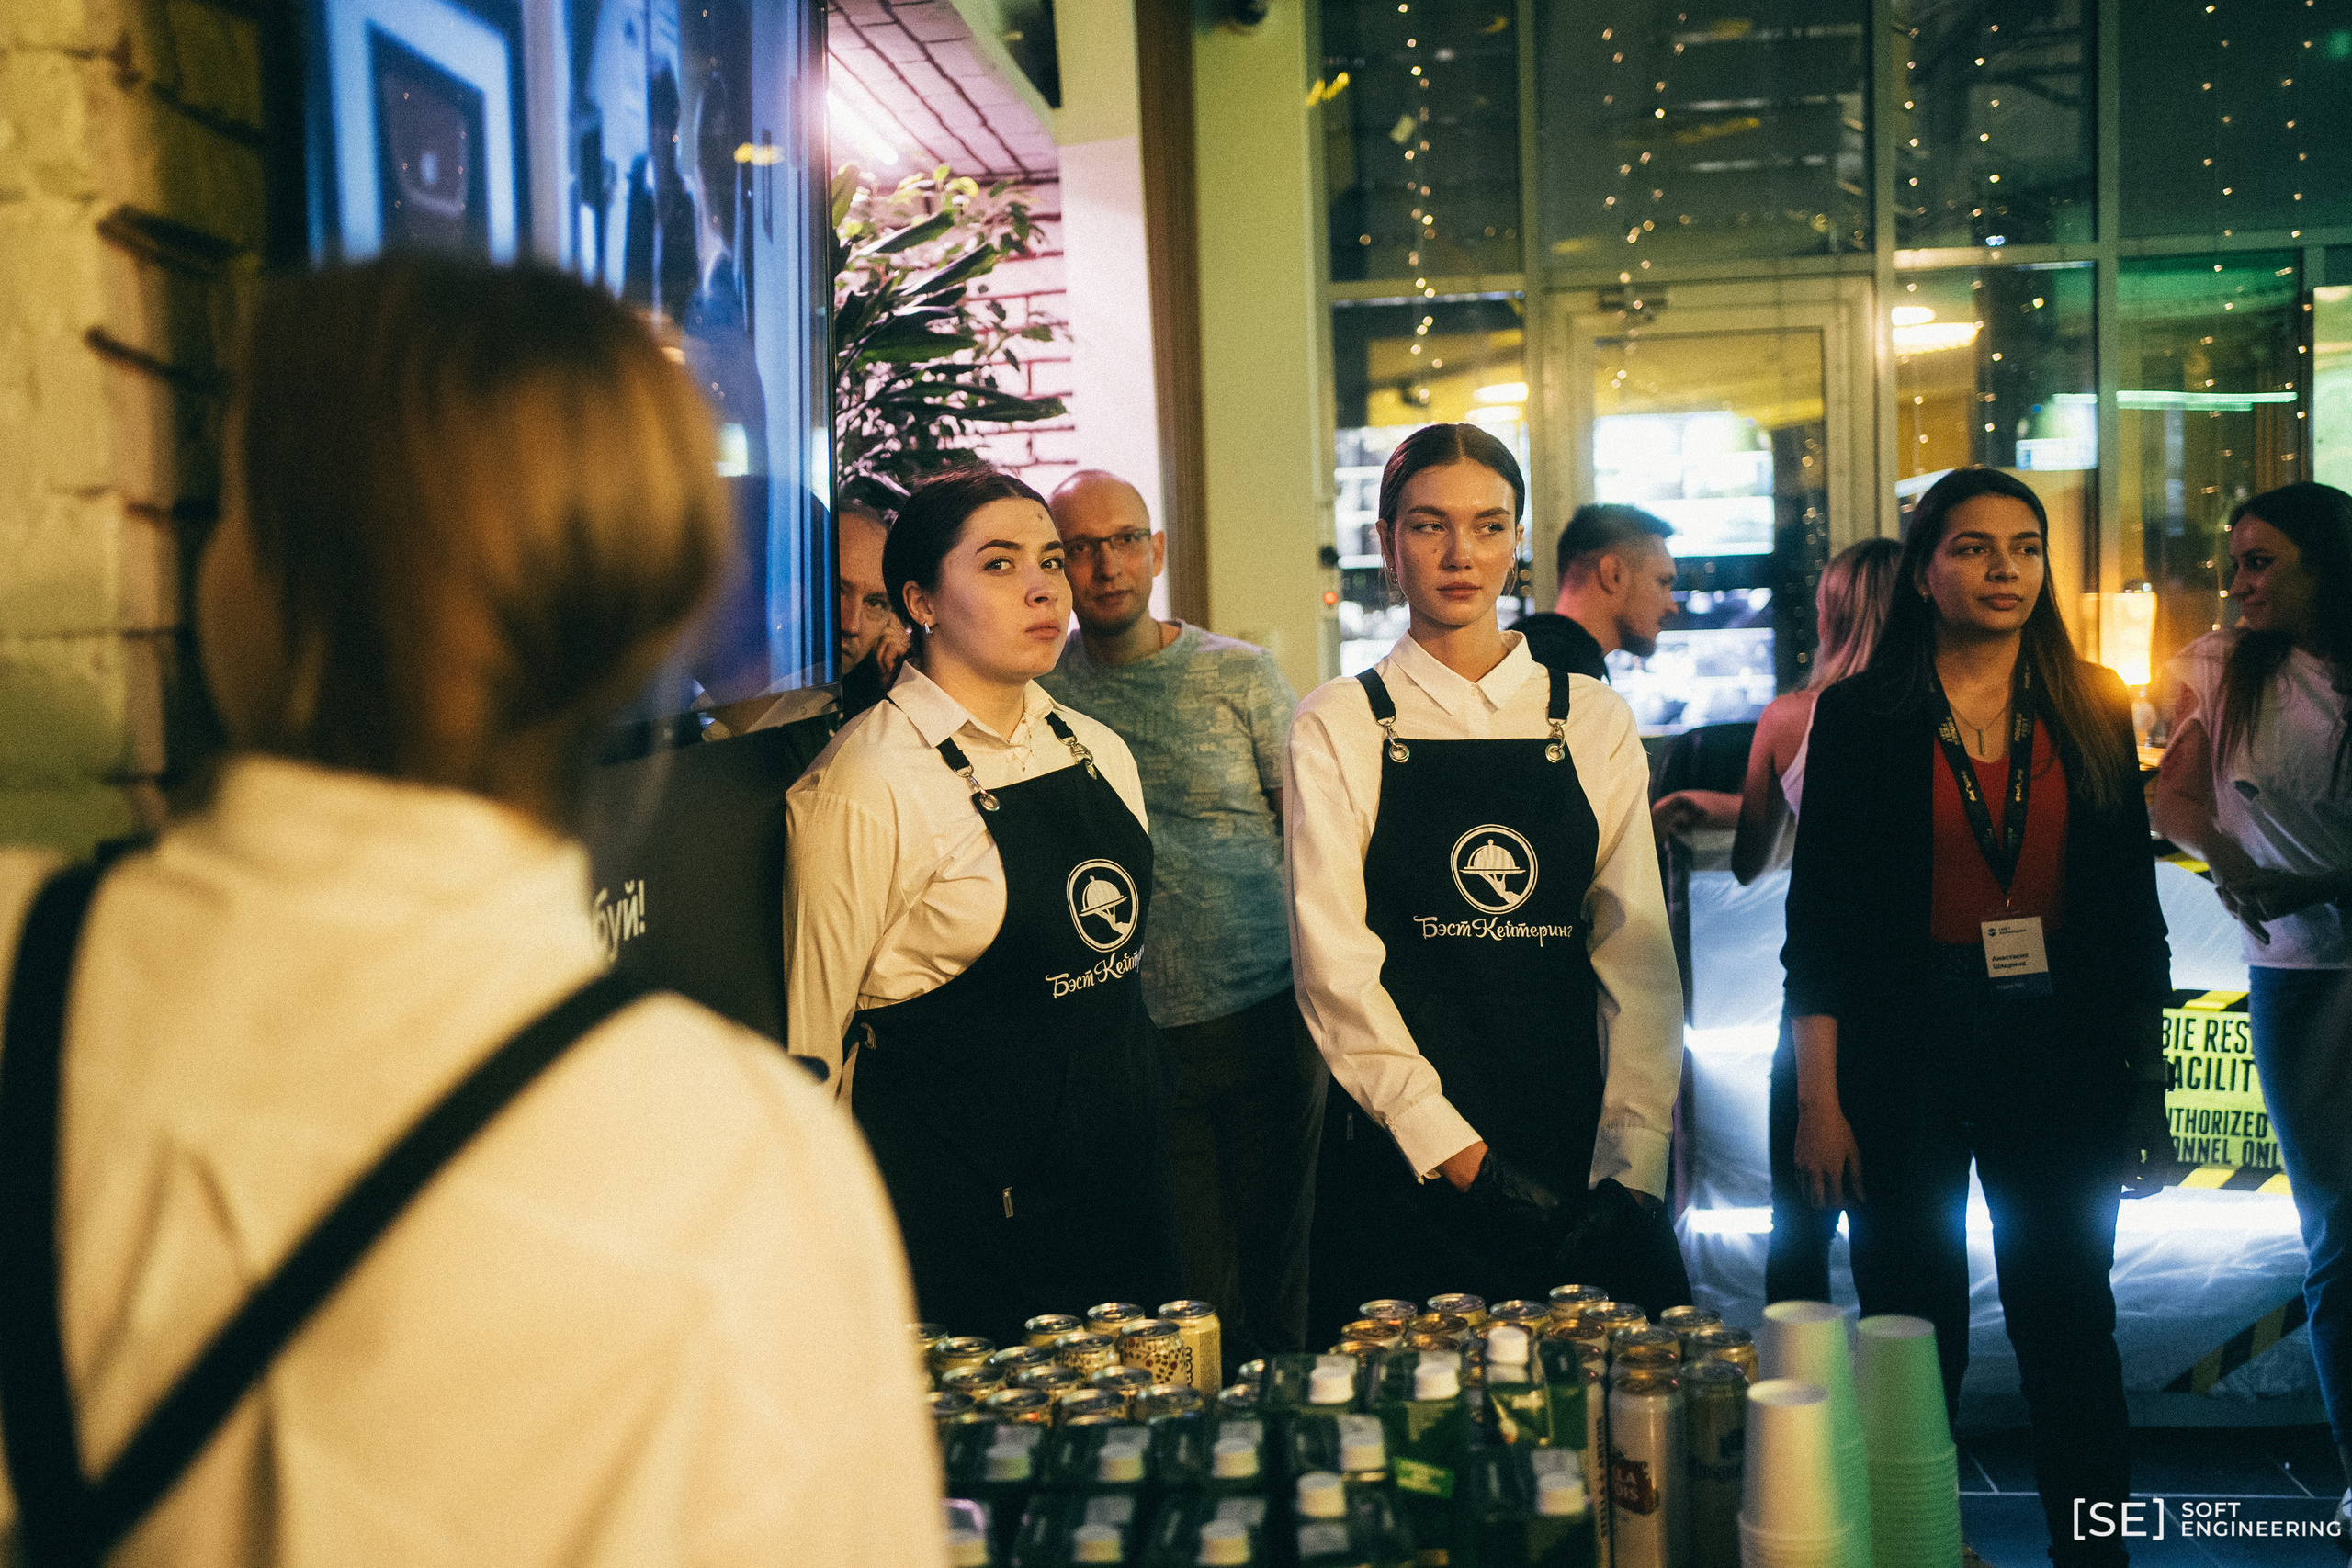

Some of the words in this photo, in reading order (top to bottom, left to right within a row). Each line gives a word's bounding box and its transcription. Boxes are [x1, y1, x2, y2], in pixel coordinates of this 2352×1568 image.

[1413, 915, 1472, 940] Бэст
[1045, 968, 1095, 999] Бэст
[2203, 1019, 2251, 1054] RES
[2162, 1055, 2256, 1092] ACILIT
